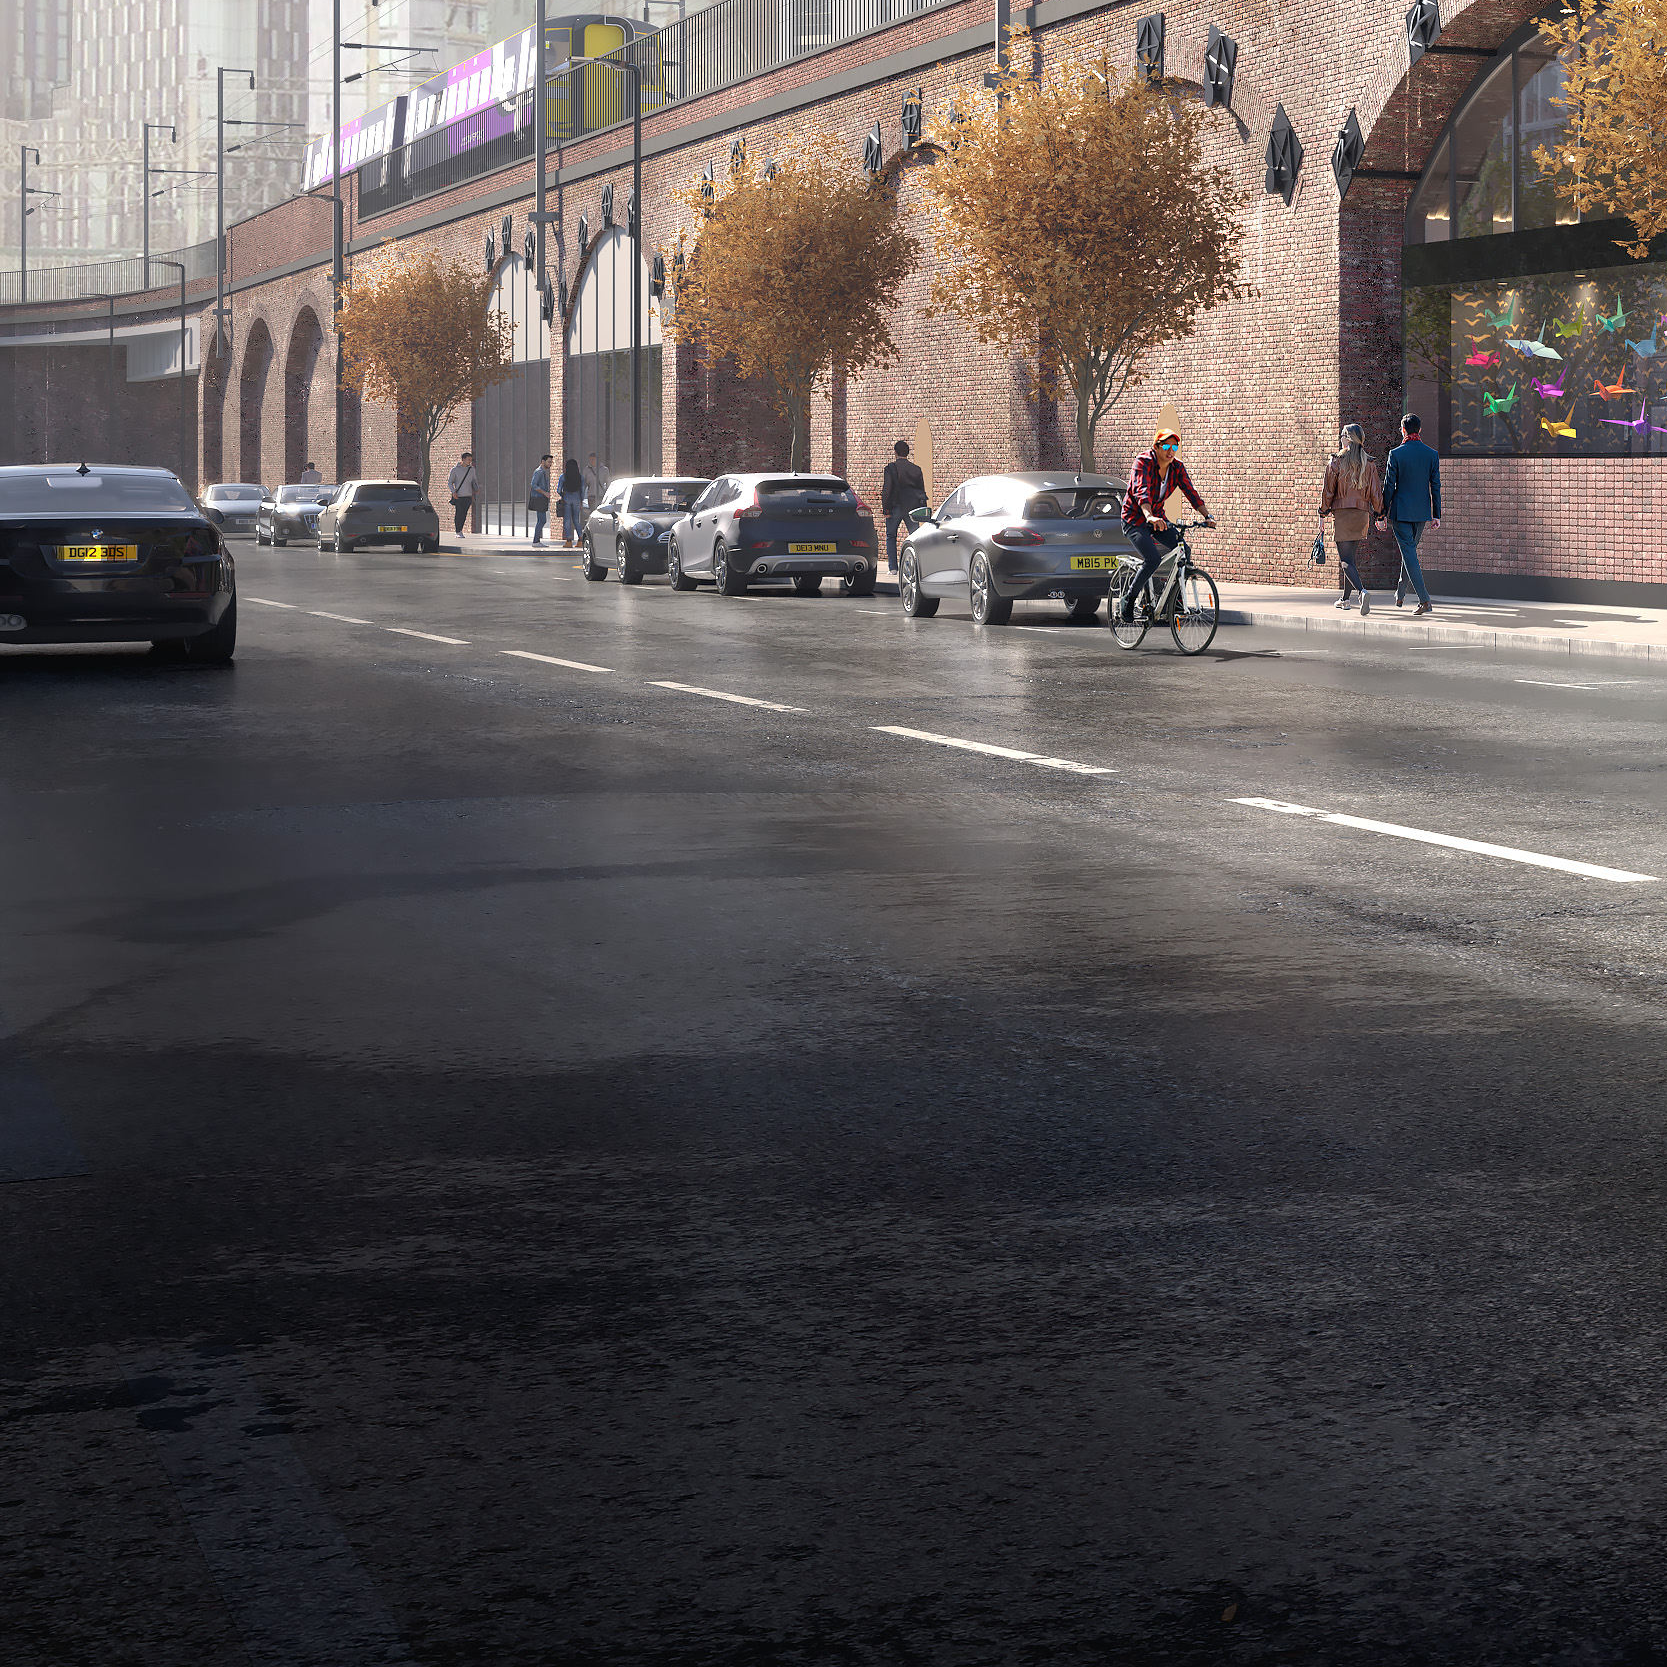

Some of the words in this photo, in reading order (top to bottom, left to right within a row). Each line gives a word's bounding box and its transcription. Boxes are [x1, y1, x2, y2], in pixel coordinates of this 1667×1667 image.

[69, 548, 97, 557] DG12
[1077, 557, 1100, 569] MB15
[1104, 557, 1118, 568] PK
